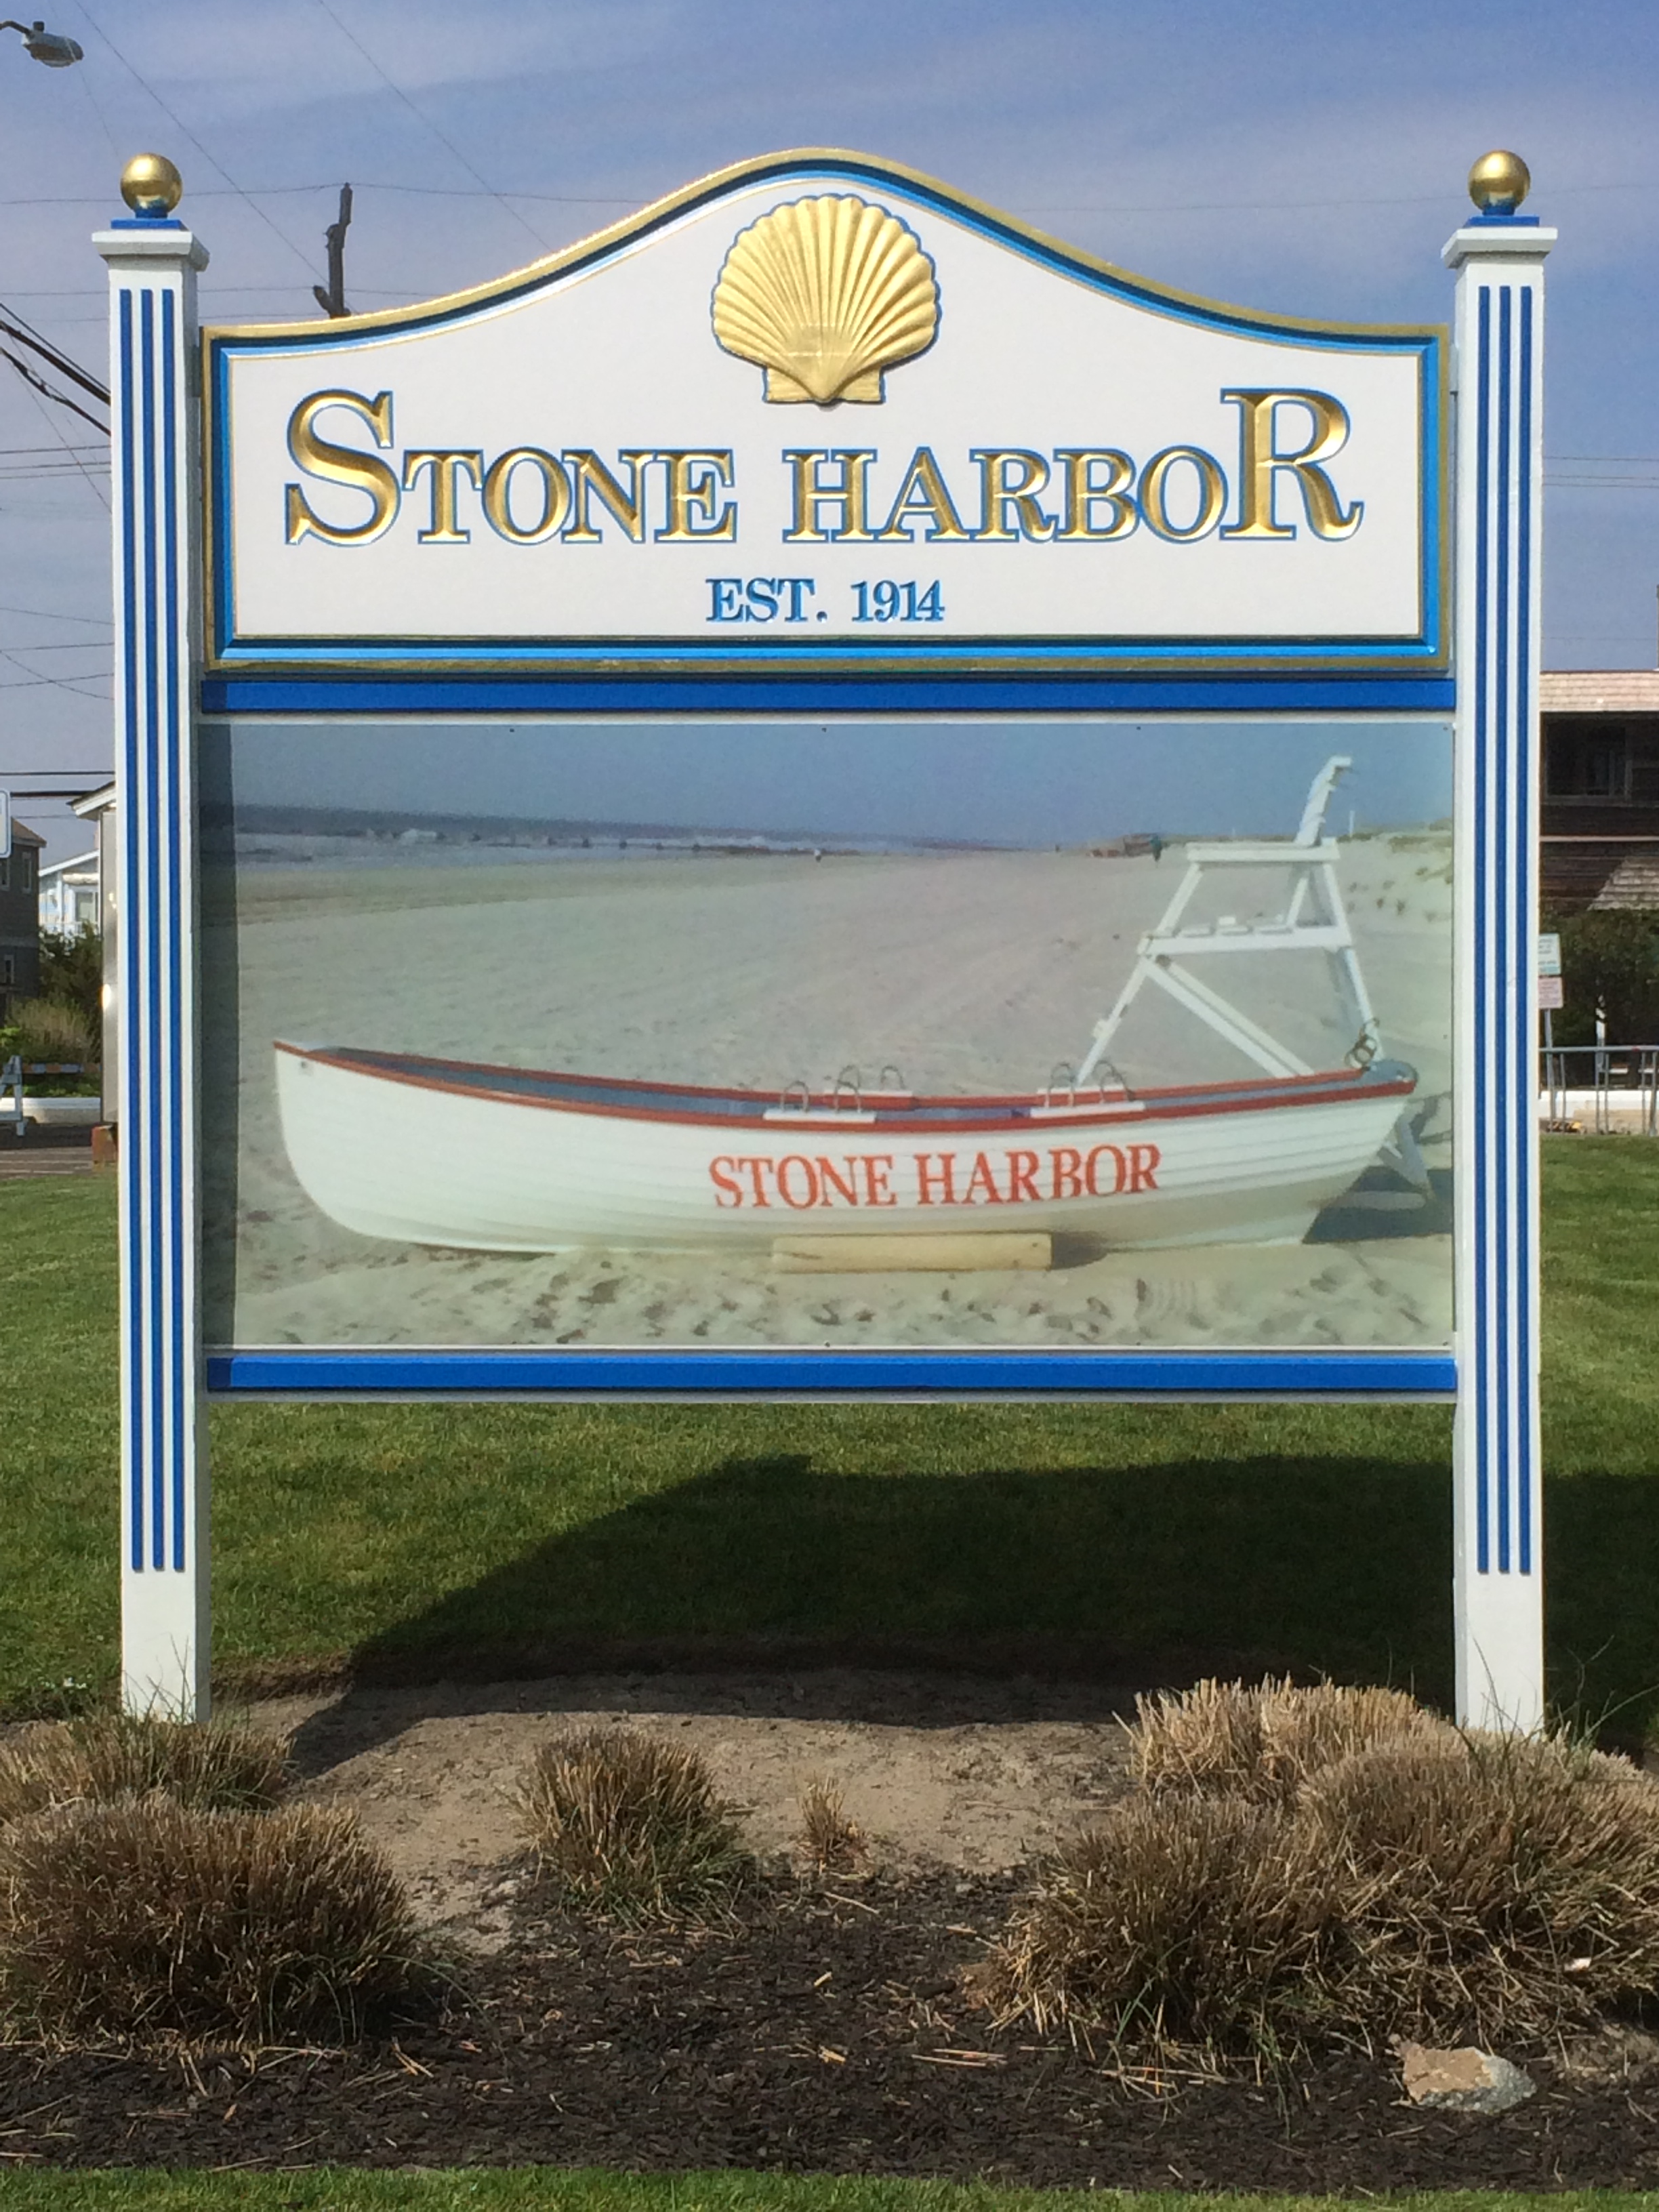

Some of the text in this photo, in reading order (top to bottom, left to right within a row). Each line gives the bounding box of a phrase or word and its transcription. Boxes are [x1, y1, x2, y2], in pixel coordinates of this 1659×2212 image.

[285, 388, 1364, 546] STONE HARBOR
[705, 577, 945, 623] EST. 1914
[709, 1143, 1162, 1210] STONE HARBOR
